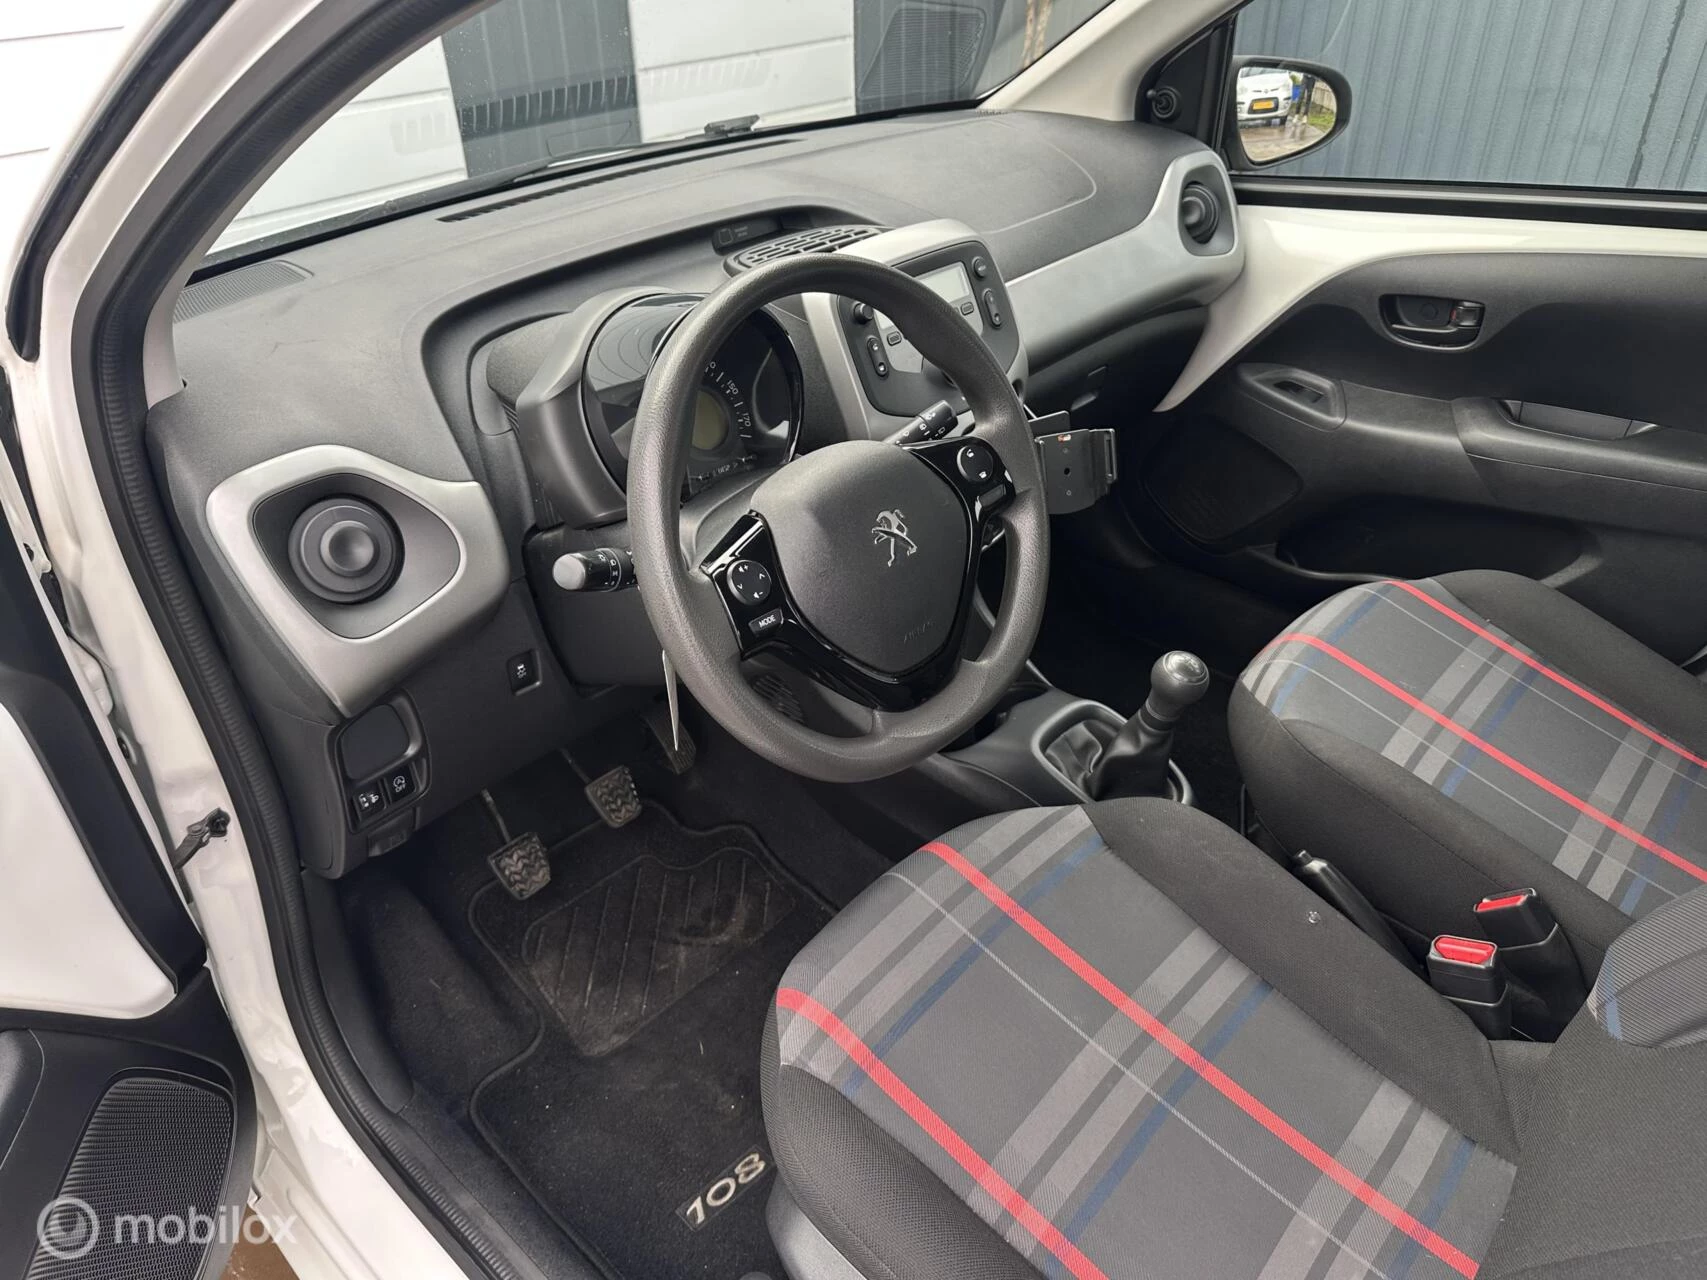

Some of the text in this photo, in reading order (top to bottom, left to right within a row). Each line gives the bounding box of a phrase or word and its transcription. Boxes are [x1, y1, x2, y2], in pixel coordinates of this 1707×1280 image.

[727, 380, 739, 395] 150
[742, 412, 752, 427] 170
[758, 614, 776, 628] MODE
[686, 1153, 766, 1225] 108
